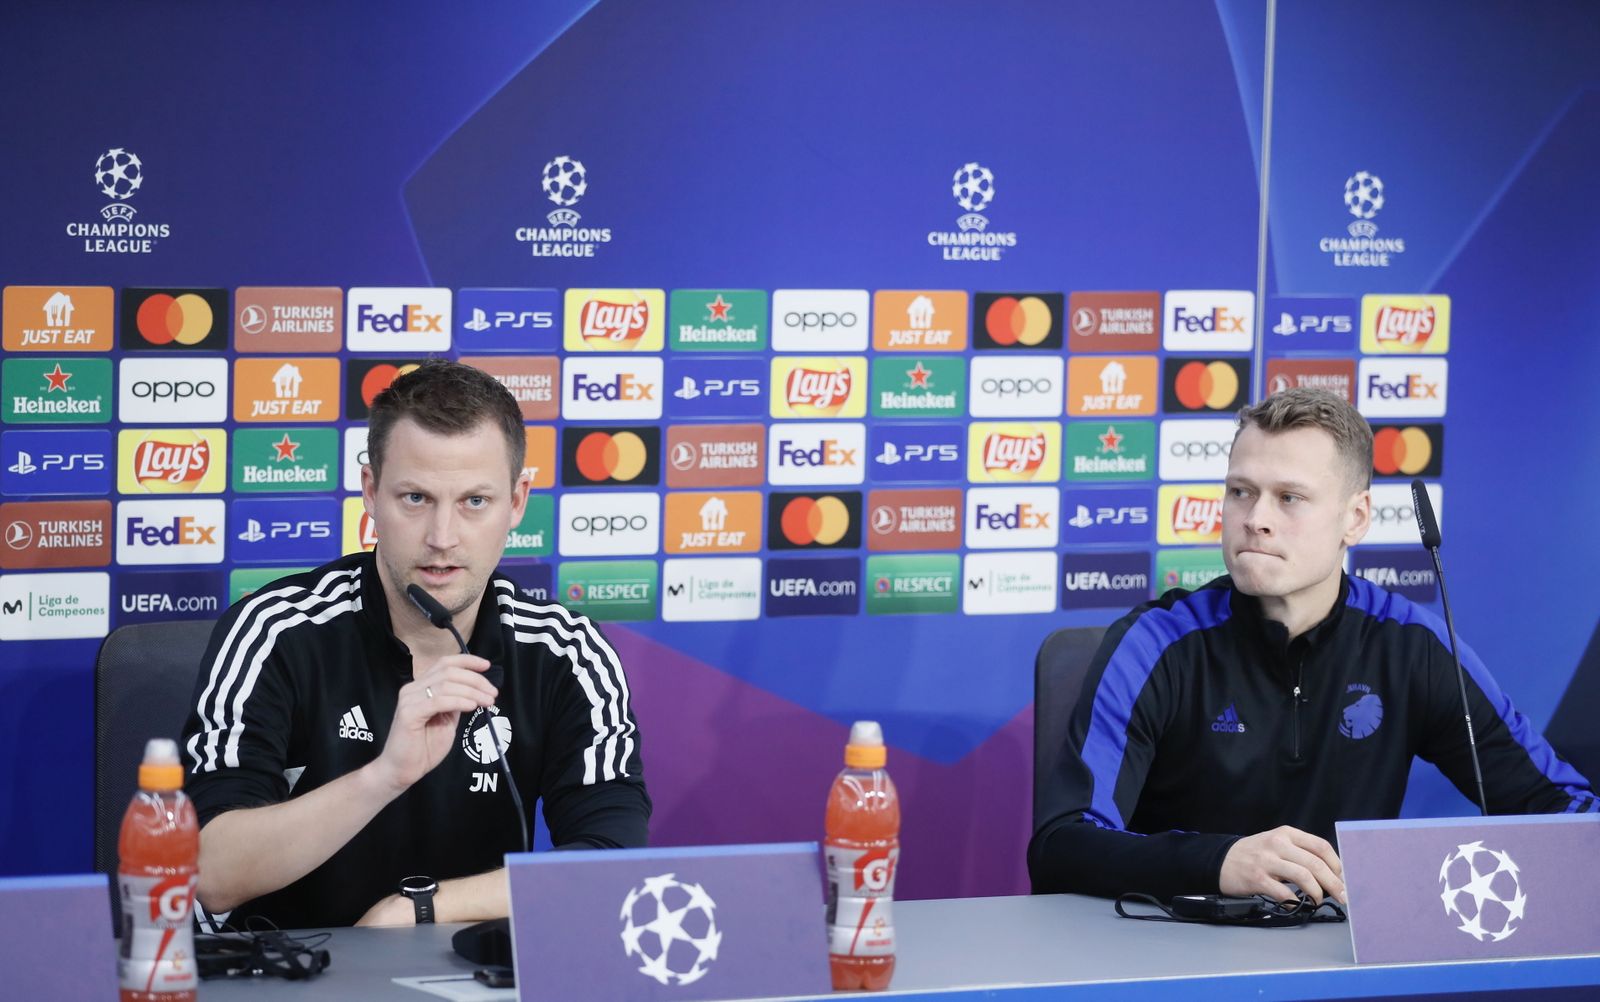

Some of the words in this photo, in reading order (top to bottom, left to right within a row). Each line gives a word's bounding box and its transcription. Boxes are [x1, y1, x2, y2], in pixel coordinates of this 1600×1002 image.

[102, 206, 134, 219] UEFA
[66, 222, 170, 237] CHAMPIONS
[515, 227, 612, 242] CHAMPIONS
[85, 239, 152, 253] LEAGUE
[927, 231, 1017, 247] CHAMPIONS
[1319, 238, 1405, 253] CHAMPIONS
[532, 243, 595, 257] LEAGUE
[943, 246, 1001, 261] LEAGUE
[1334, 252, 1390, 267] LEAGUE
[271, 306, 334, 319] TURKISH
[357, 304, 443, 333] FedEx
[495, 311, 553, 328] PS5
[583, 300, 647, 341] Lay's
[1099, 308, 1154, 321] TURKISH
[1174, 307, 1246, 333] FedEx
[271, 319, 335, 333] AIRLINES
[784, 312, 857, 331] oppo
[1099, 321, 1154, 334] AIRLINES
[1301, 316, 1353, 333] PS5
[21, 330, 61, 346] JUST
[64, 329, 95, 345] EAT
[679, 325, 757, 343] Heineken
[888, 330, 922, 347] JUST
[923, 330, 952, 345] EAT
[132, 381, 215, 402] oppo
[573, 374, 654, 401] FedEx
[704, 380, 760, 396] PS5
[981, 378, 1051, 397] oppo
[1368, 374, 1440, 400] FedEx
[13, 396, 101, 414] Heineken
[252, 400, 291, 416] JUST
[292, 400, 322, 415] EAT
[881, 392, 955, 409] Heineken
[1081, 395, 1115, 412] JUST
[1117, 395, 1142, 410] EAT
[700, 443, 757, 455] TURKISH
[779, 440, 856, 466] FedEx
[905, 445, 958, 461] PS5
[43, 455, 104, 470] PS5
[139, 440, 207, 483] Lay's
[700, 455, 757, 469] AIRLINES
[1074, 456, 1147, 473] Heineken
[243, 465, 328, 483] Heineken
[899, 507, 954, 519] TURKISH
[976, 504, 1049, 530] FedEx
[1097, 508, 1148, 524] PS5
[39, 520, 103, 534] TURKISH
[126, 517, 216, 546] FedEx
[271, 522, 330, 538] PS5
[572, 515, 647, 535] oppo
[899, 519, 954, 532] AIRLINES
[38, 534, 103, 548] AIRLINES
[680, 533, 716, 549] JUST
[717, 532, 746, 547] EAT
[771, 579, 856, 596] UEFA.com
[894, 577, 952, 592] RESPECT
[1066, 571, 1147, 590] UEFA.com
[588, 584, 649, 600] RESPECT
[38, 595, 63, 608] Liga
[65, 594, 79, 605] de
[122, 594, 217, 611] UEFA.com
[38, 605, 105, 618] Campeones
[339, 725, 373, 742] adidas
[469, 772, 498, 792] JN
